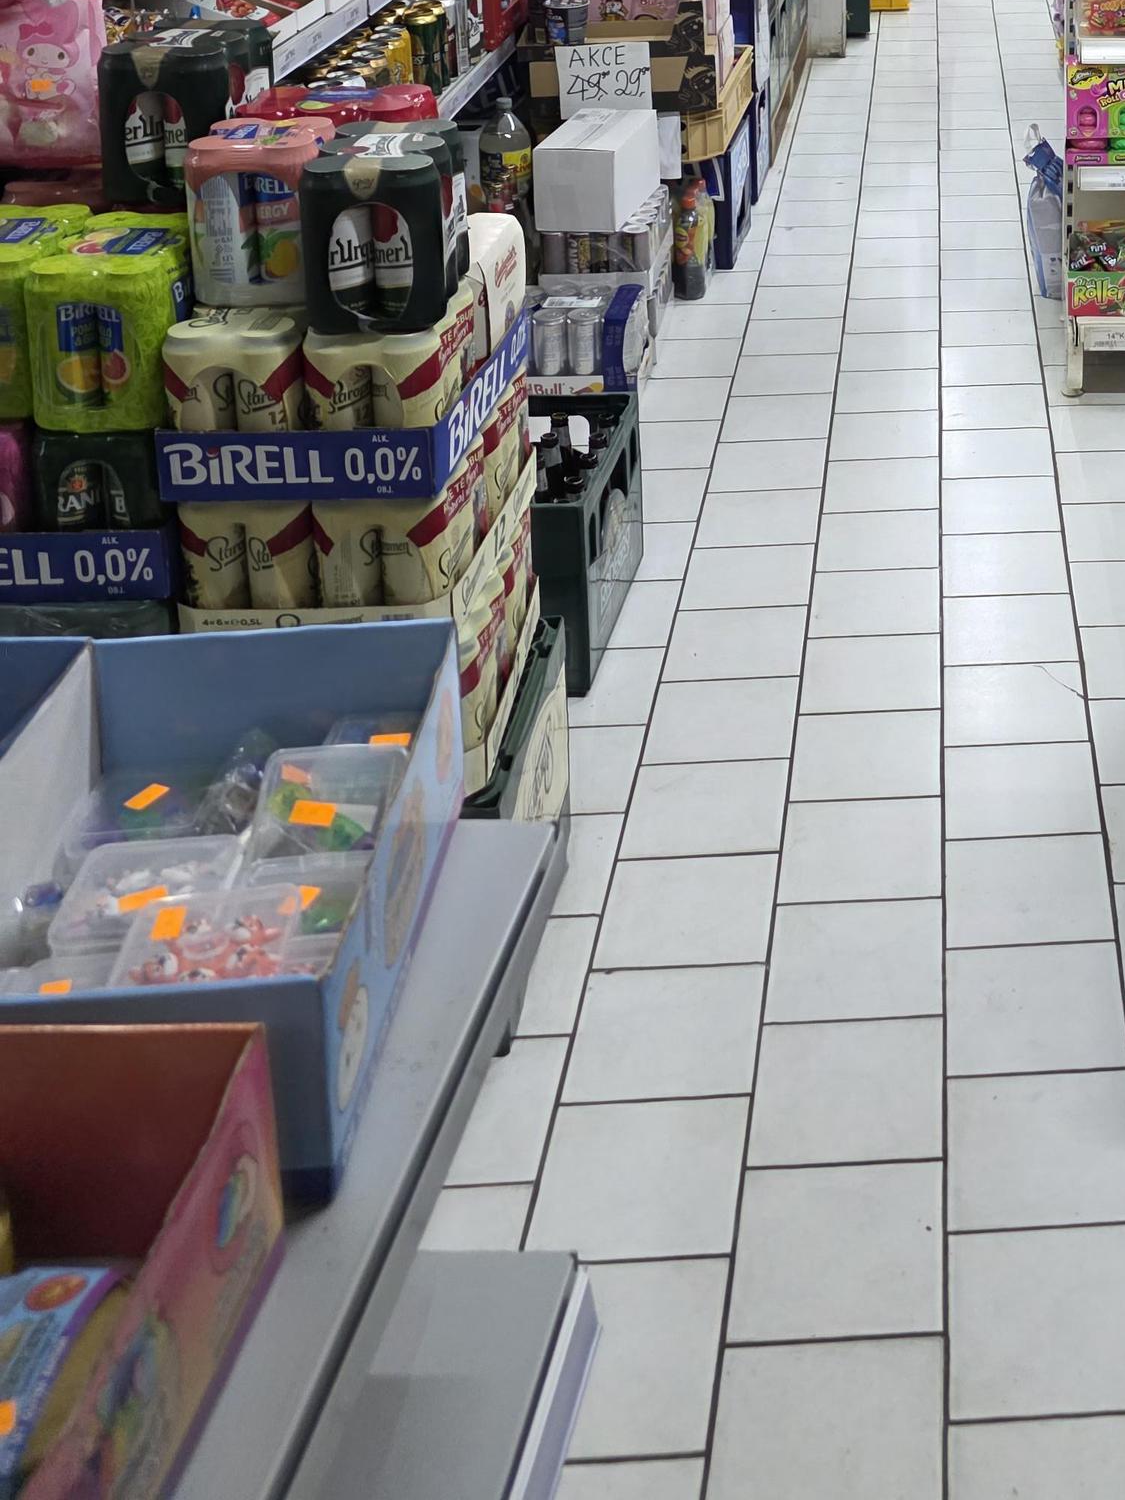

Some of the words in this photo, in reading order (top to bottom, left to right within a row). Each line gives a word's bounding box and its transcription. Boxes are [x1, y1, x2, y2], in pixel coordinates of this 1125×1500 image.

[568, 45, 625, 68] AKCE
[344, 447, 422, 484] 0,0%
[74, 548, 154, 585] 0,0%
